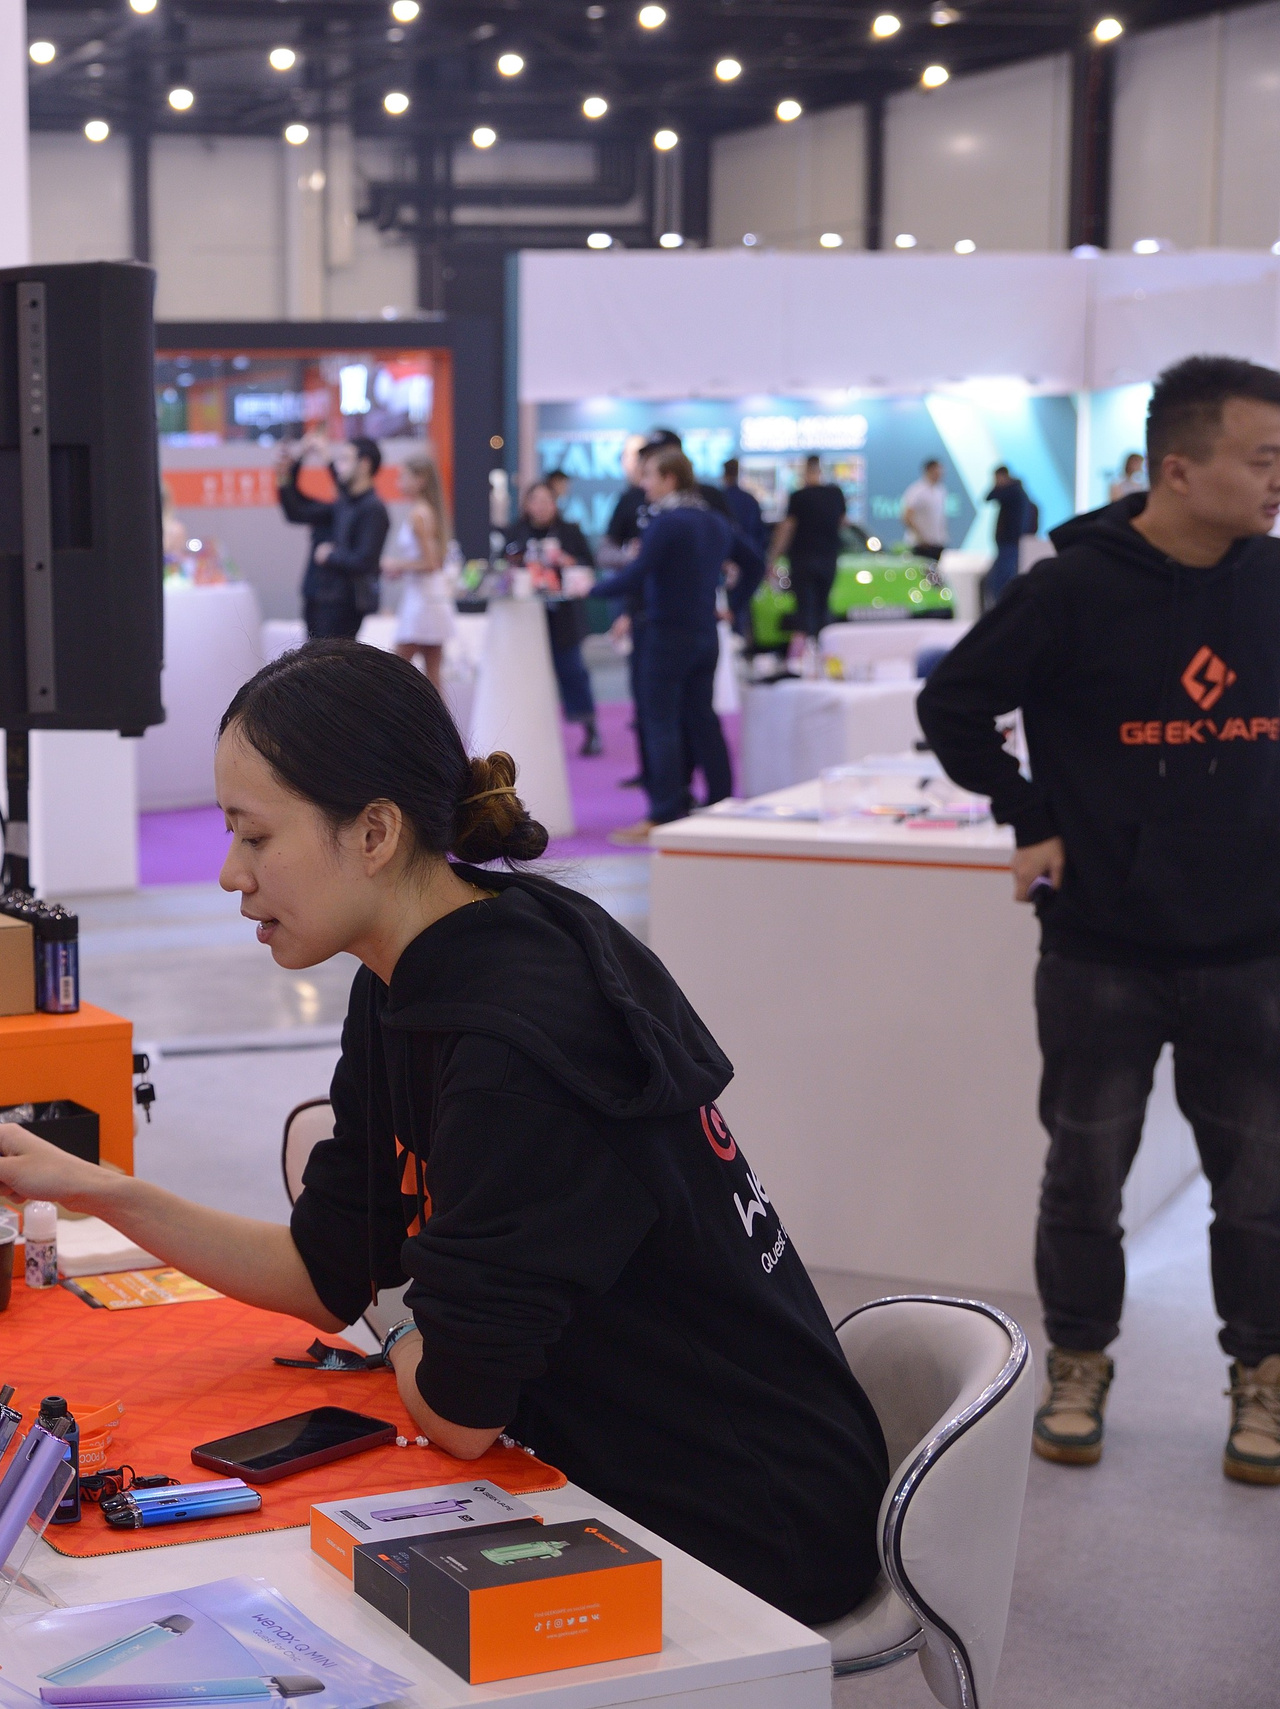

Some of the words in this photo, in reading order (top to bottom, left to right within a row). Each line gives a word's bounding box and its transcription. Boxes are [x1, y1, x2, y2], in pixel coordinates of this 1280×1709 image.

[1120, 716, 1280, 746] GEEKVAPE
[761, 1228, 786, 1274] Quest
[294, 1643, 310, 1652] Q
[304, 1651, 338, 1668] MINI
